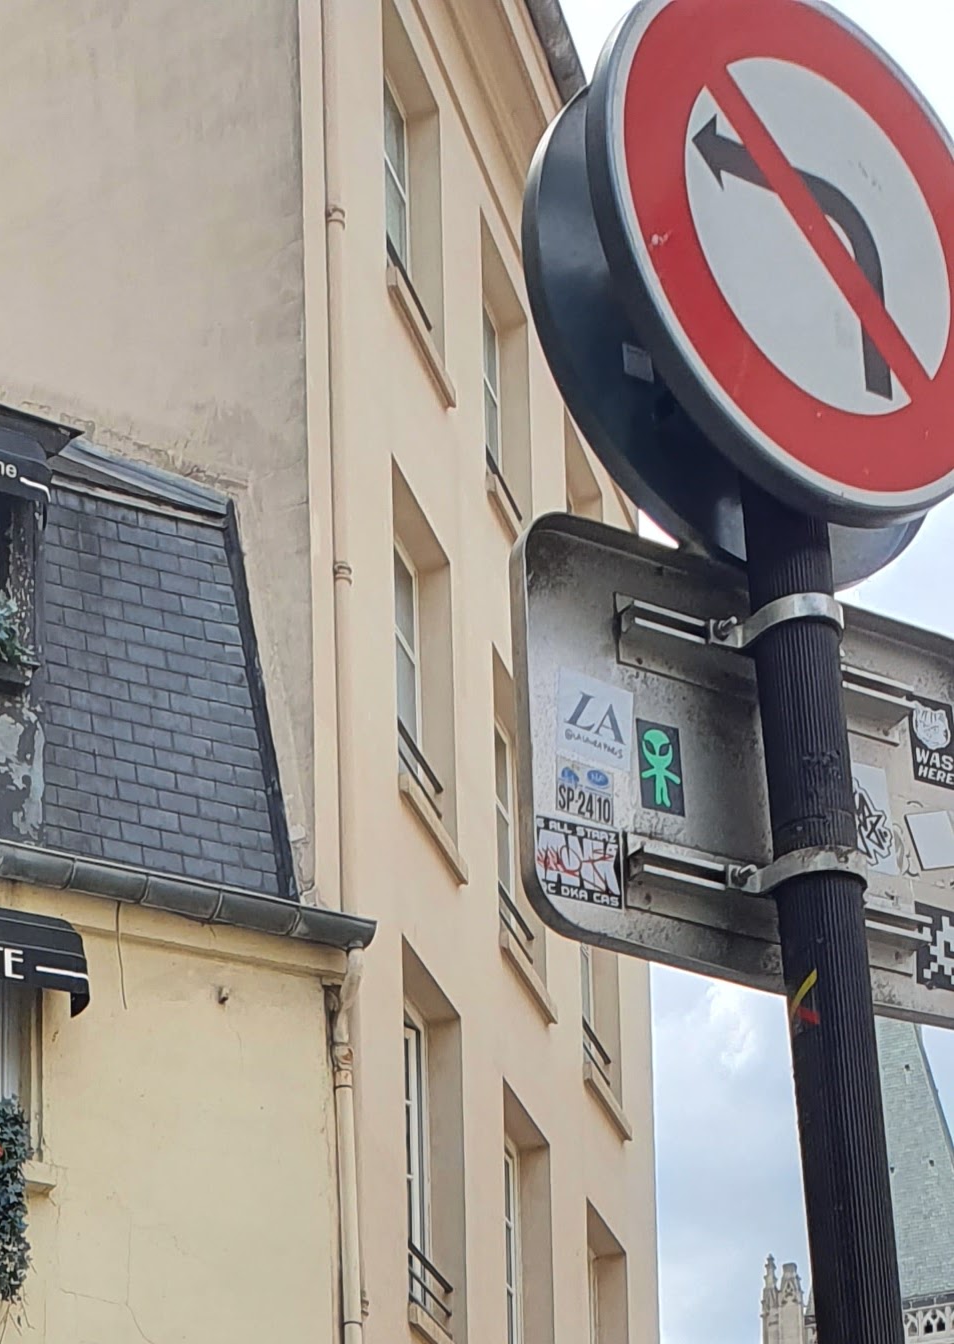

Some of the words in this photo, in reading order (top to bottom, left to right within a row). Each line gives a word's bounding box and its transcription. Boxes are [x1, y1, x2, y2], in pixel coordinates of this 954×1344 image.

[564, 691, 626, 745] LA
[916, 747, 954, 771] WAS
[918, 765, 954, 785] HERE
[549, 821, 572, 834] ALL
[576, 826, 616, 843] STARZ
[561, 885, 588, 900] DKA
[593, 892, 619, 907] CAS
